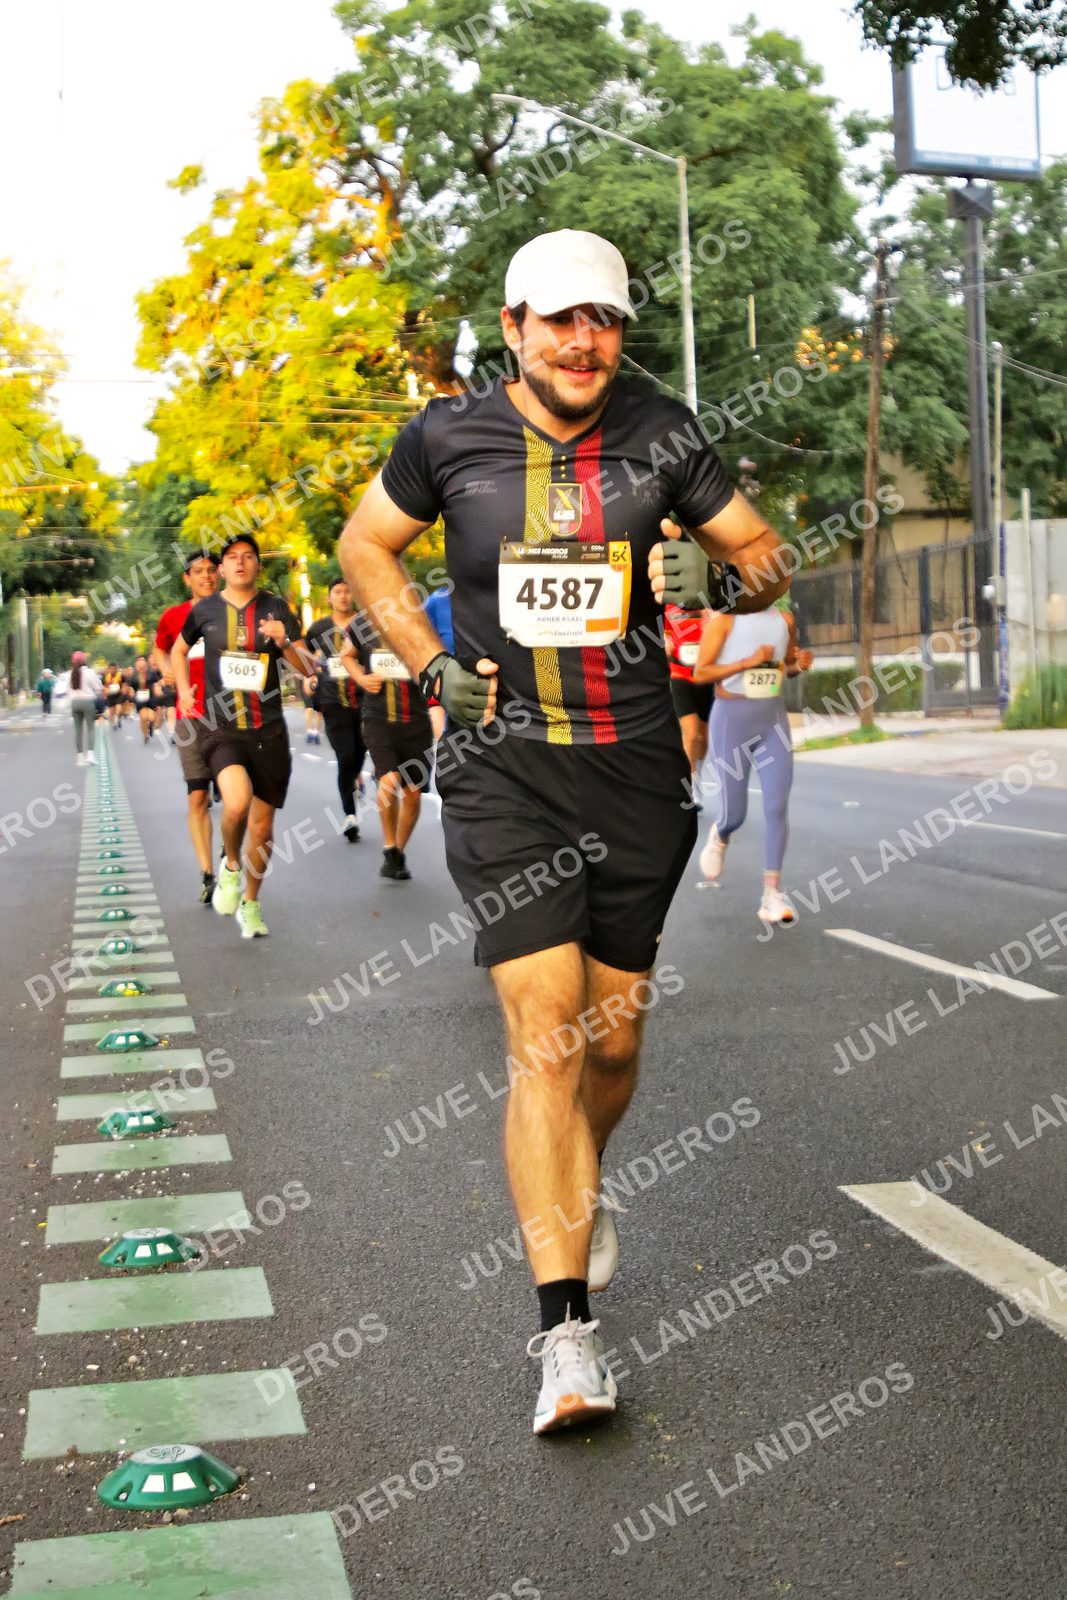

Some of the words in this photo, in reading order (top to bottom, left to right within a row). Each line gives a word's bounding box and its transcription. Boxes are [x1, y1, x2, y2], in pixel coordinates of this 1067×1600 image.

[516, 577, 604, 610] 4587
[227, 662, 257, 677] 5605
[749, 673, 777, 685] 2872
